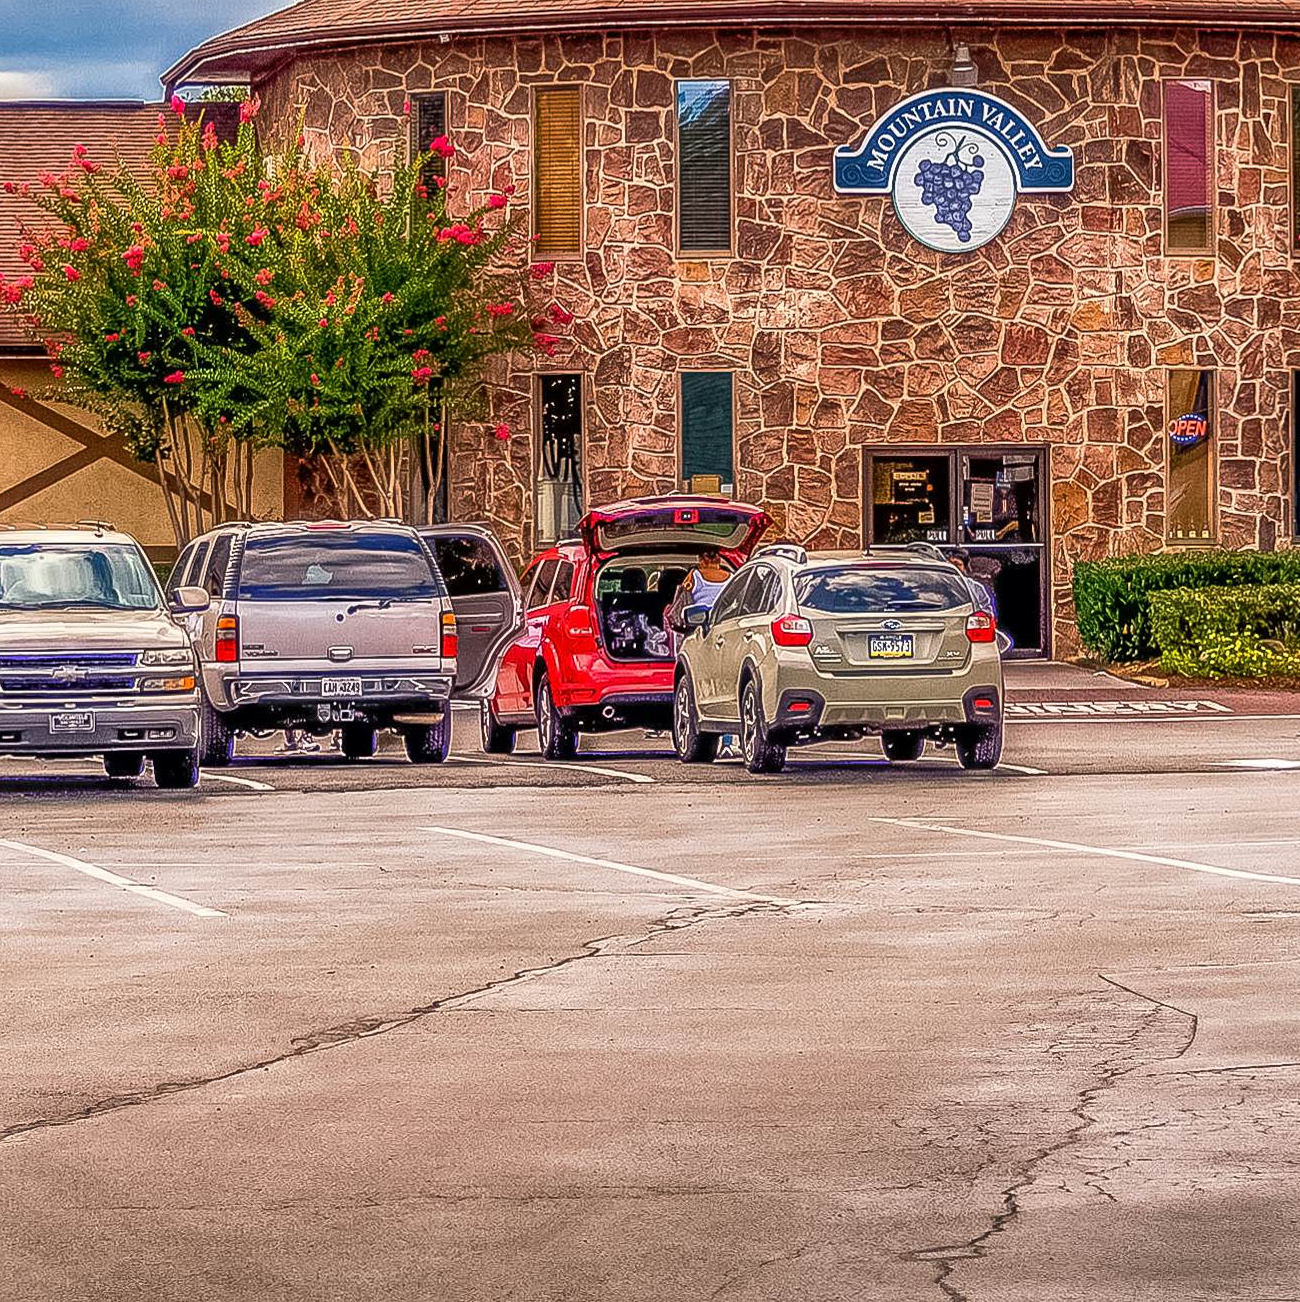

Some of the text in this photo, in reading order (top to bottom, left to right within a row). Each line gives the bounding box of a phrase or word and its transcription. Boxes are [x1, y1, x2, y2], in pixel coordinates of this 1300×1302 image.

[866, 98, 1043, 172] MOUNTAIN VALLEY
[1168, 419, 1206, 437] OPEN
